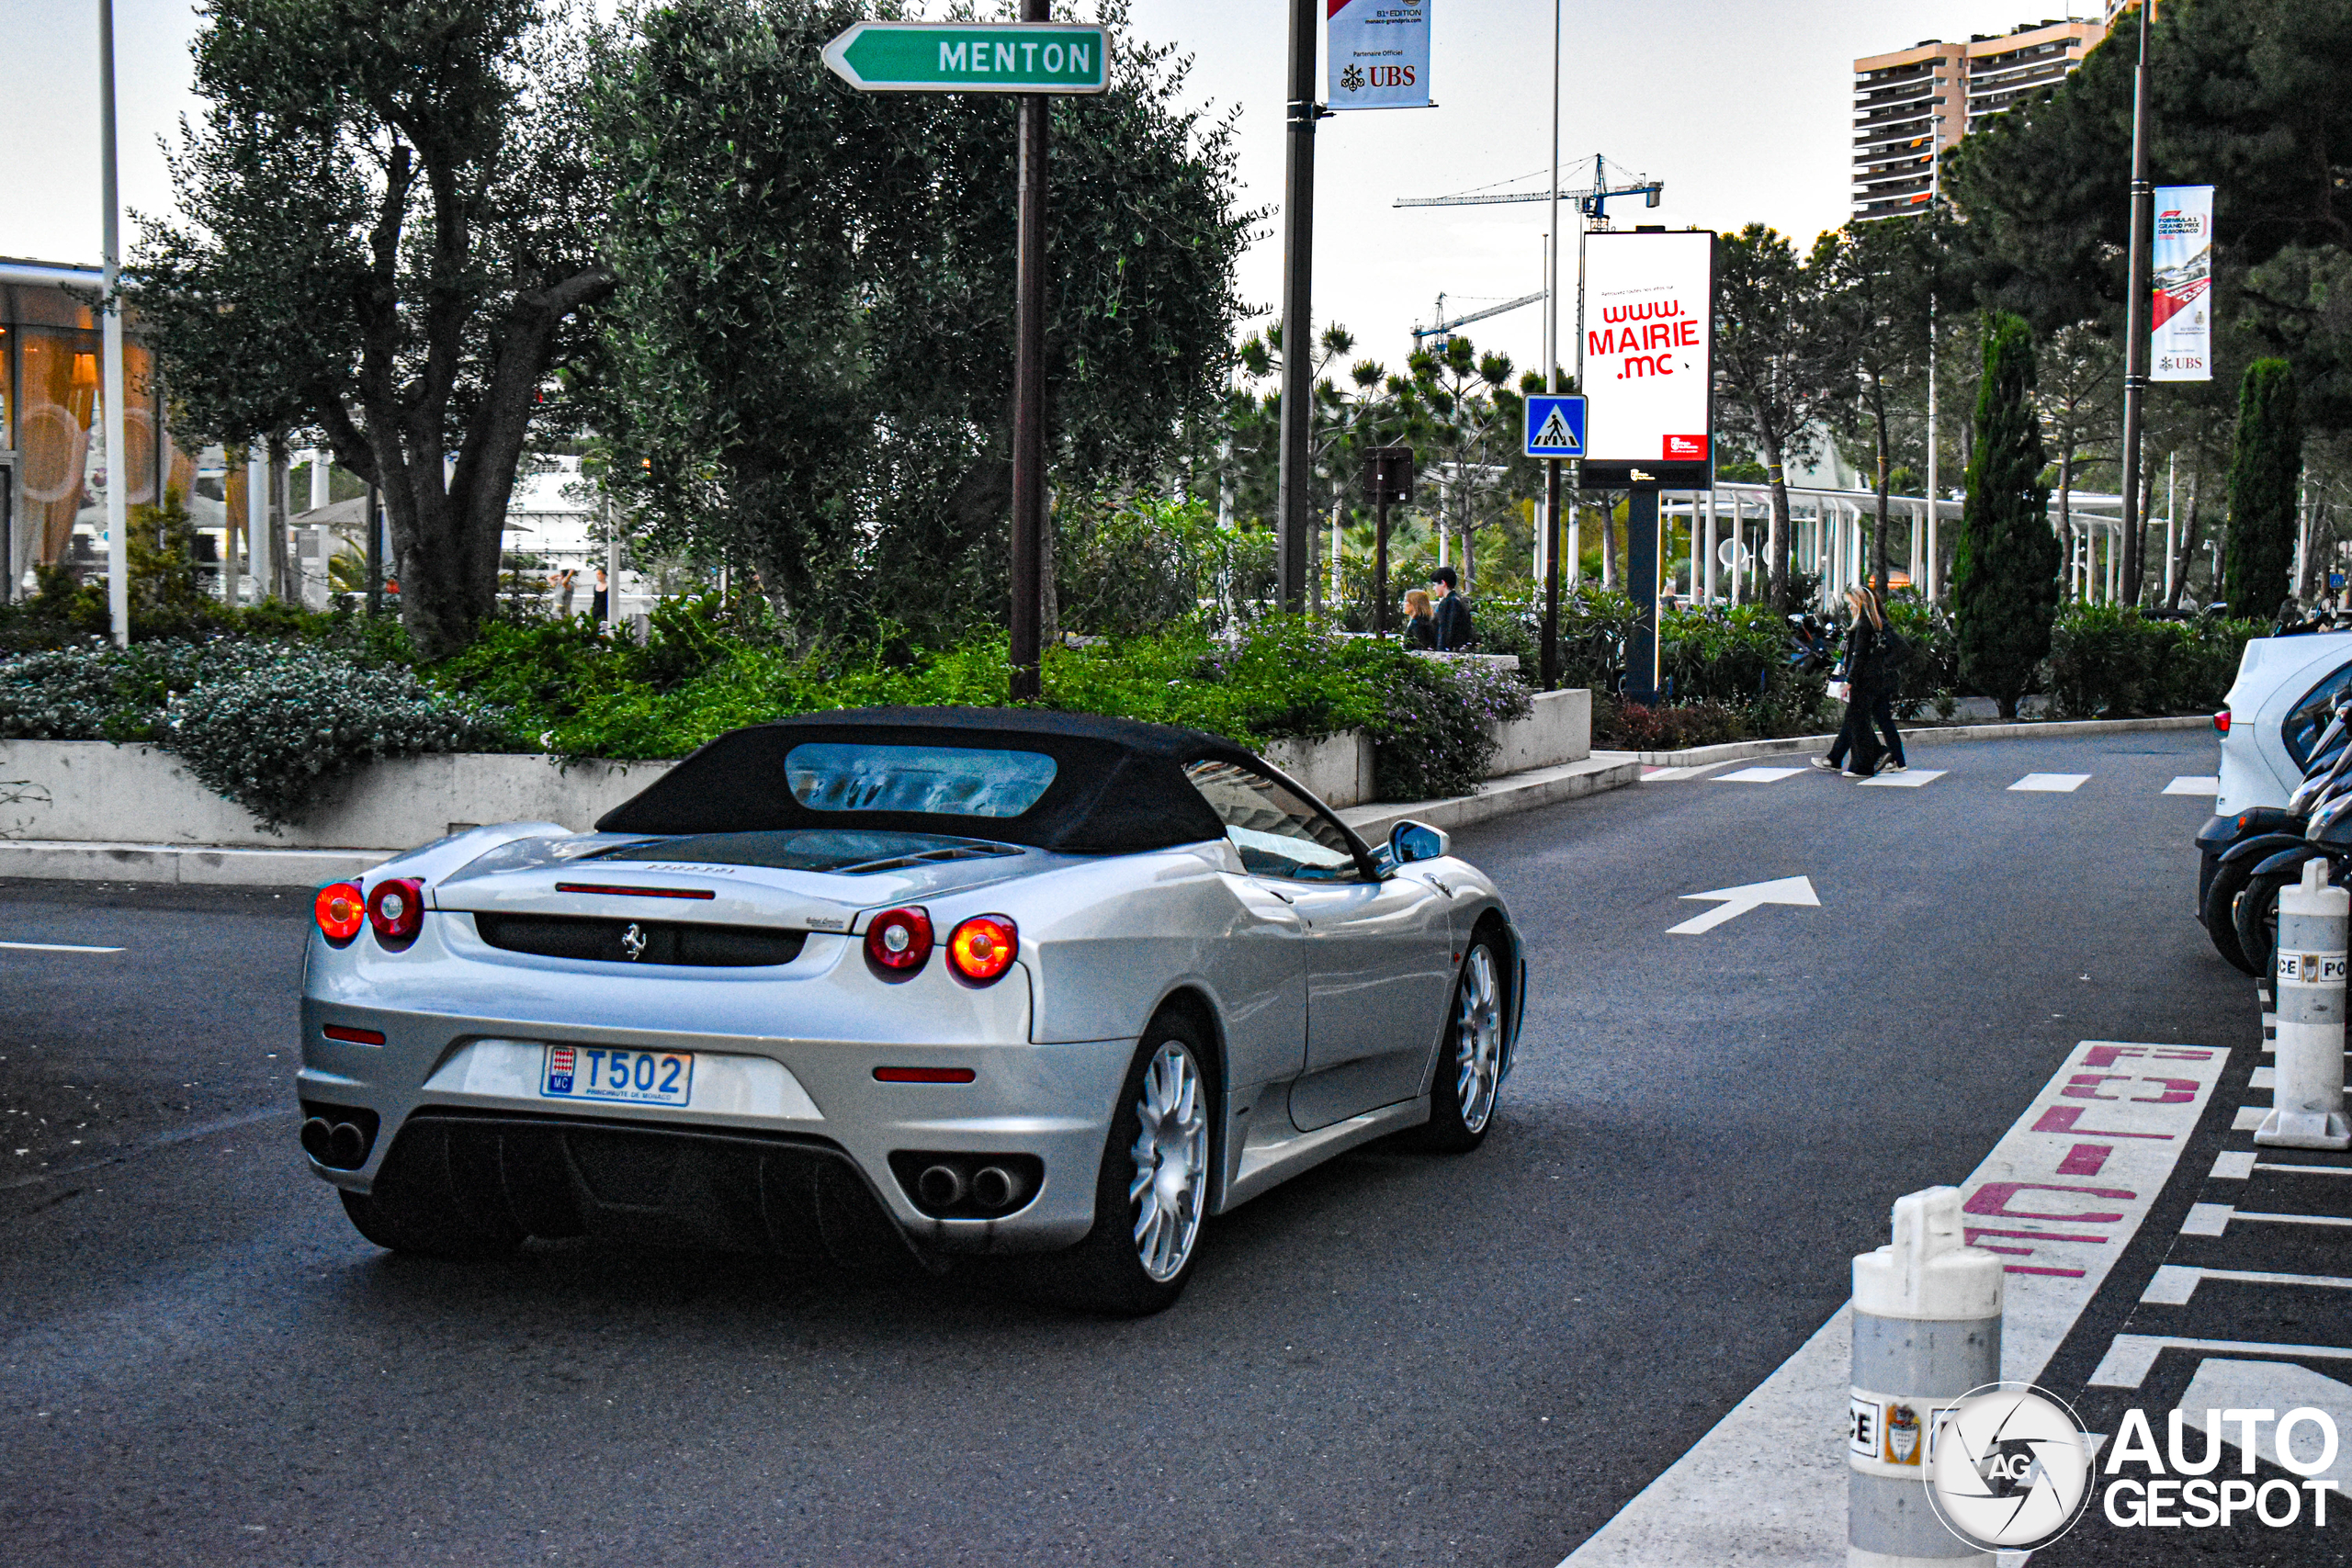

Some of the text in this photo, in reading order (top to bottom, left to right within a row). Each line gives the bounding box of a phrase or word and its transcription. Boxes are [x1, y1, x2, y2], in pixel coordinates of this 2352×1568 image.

[939, 41, 1090, 73] MENTON
[1369, 65, 1416, 87] UBS
[1603, 299, 1685, 323] www.
[1589, 320, 1700, 355] MAIRIE
[1617, 353, 1673, 379] .mc
[2176, 357, 2202, 369] UBS
[2278, 959, 2296, 974] CE
[2324, 962, 2345, 976] PO
[586, 1050, 682, 1093] T502
[553, 1077, 568, 1089] MC
[586, 1089, 628, 1098] PRINCIPAUTE
[642, 1092, 672, 1100] MONACO
